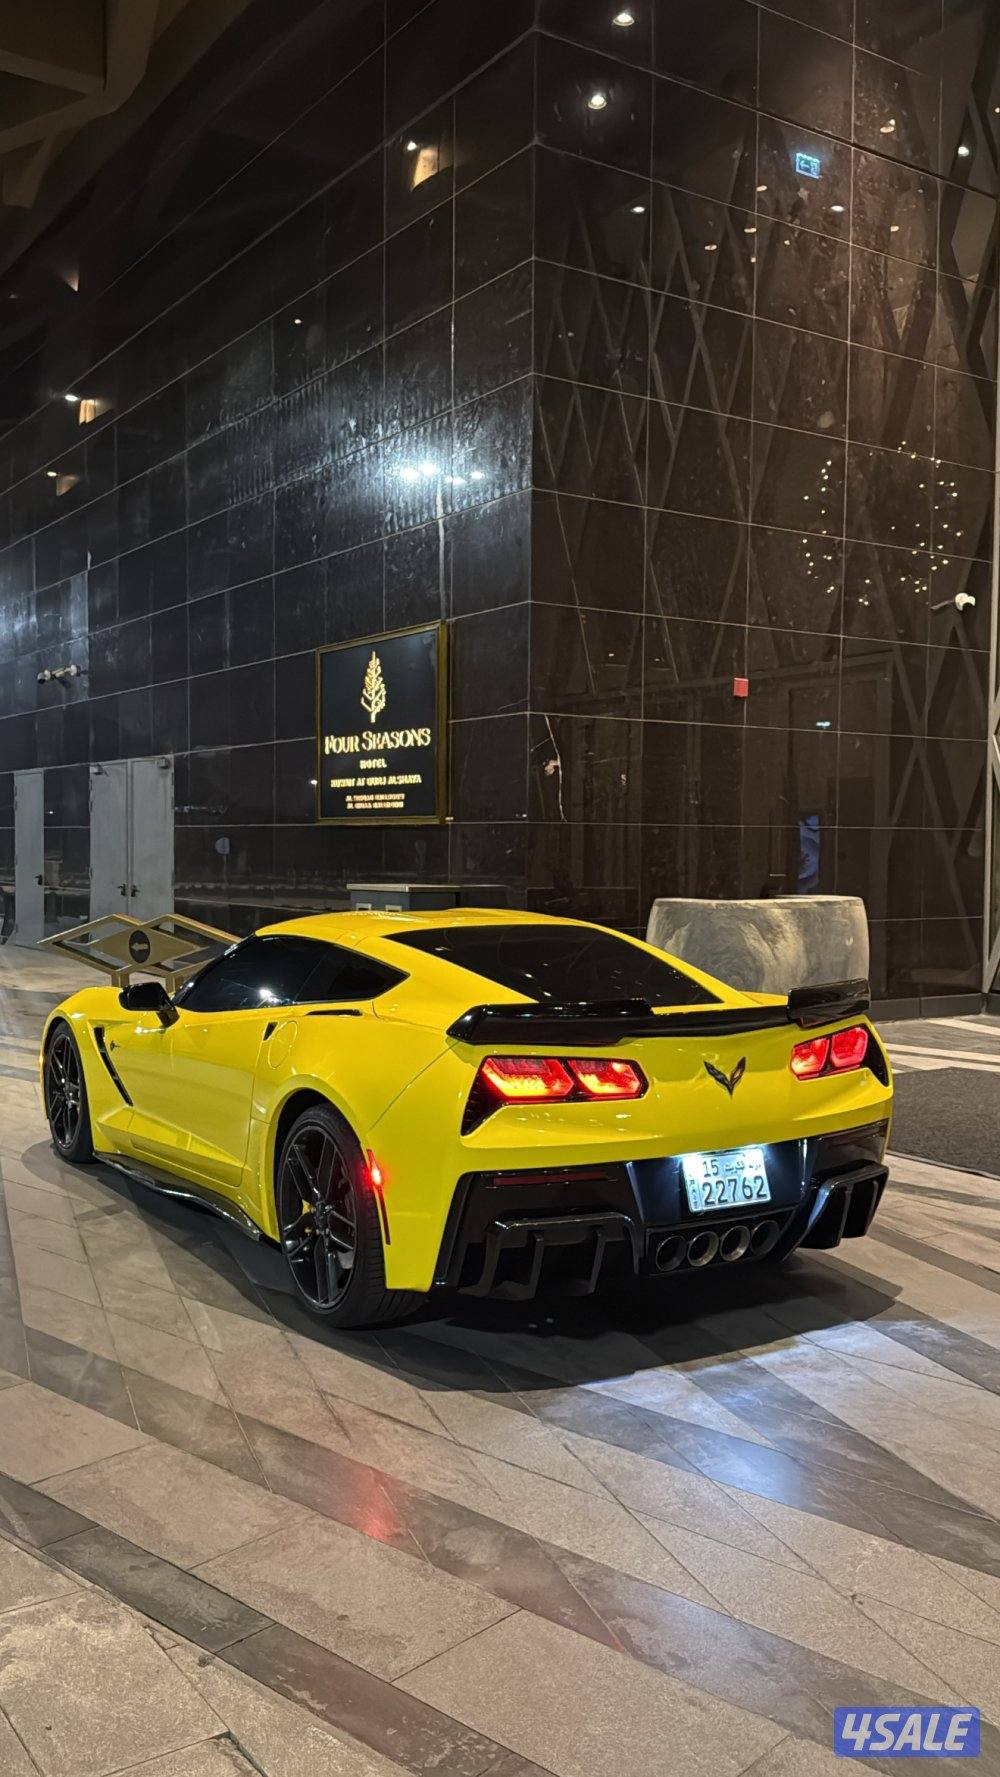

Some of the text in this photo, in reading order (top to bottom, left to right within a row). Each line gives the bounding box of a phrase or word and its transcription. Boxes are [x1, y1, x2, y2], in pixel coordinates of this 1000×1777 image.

[324, 727, 431, 755] FOUR SEASONS
[359, 758, 388, 770] HOTEL
[702, 1158, 719, 1178] 15
[702, 1175, 767, 1206] 22762
